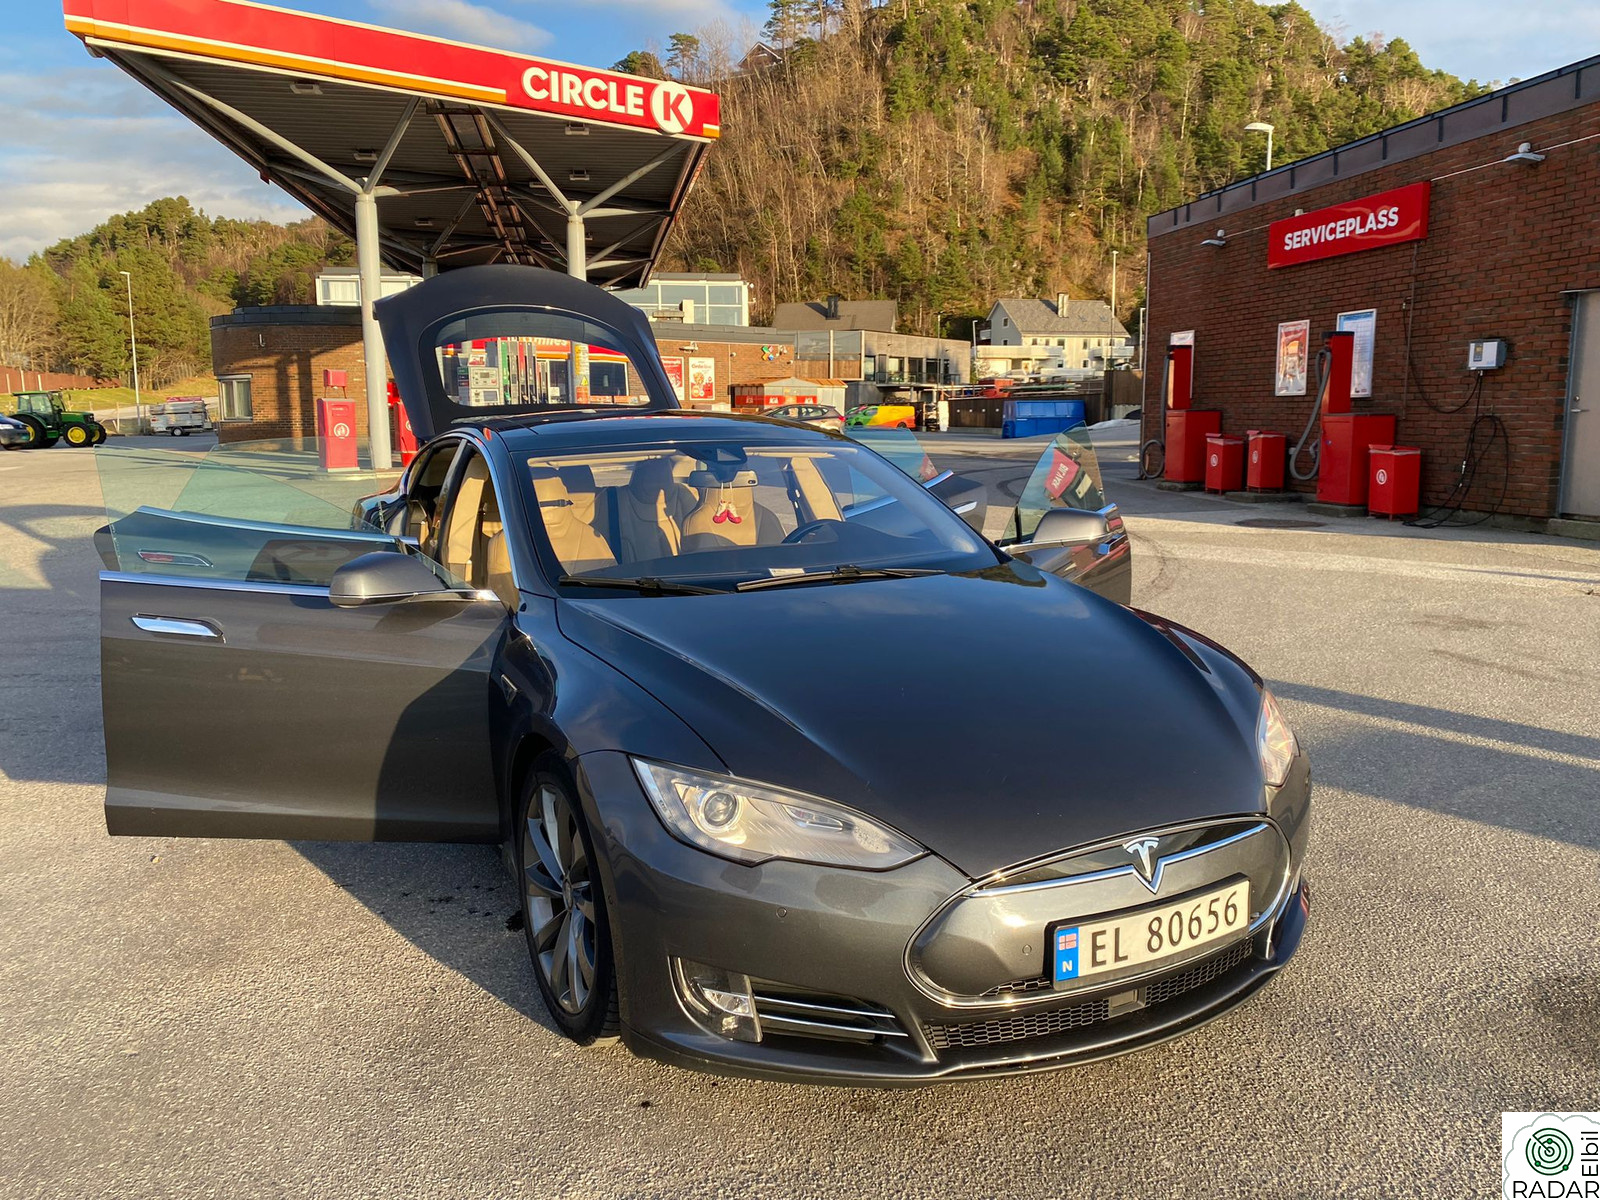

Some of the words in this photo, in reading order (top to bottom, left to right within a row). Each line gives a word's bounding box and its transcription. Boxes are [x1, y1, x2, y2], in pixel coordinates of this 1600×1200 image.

[522, 66, 644, 117] CIRCLE
[663, 90, 690, 133] K
[1284, 206, 1399, 251] SERVICEPLASS
[1091, 927, 1129, 968] EL
[1146, 890, 1239, 953] 80656
[1061, 959, 1073, 972] N
